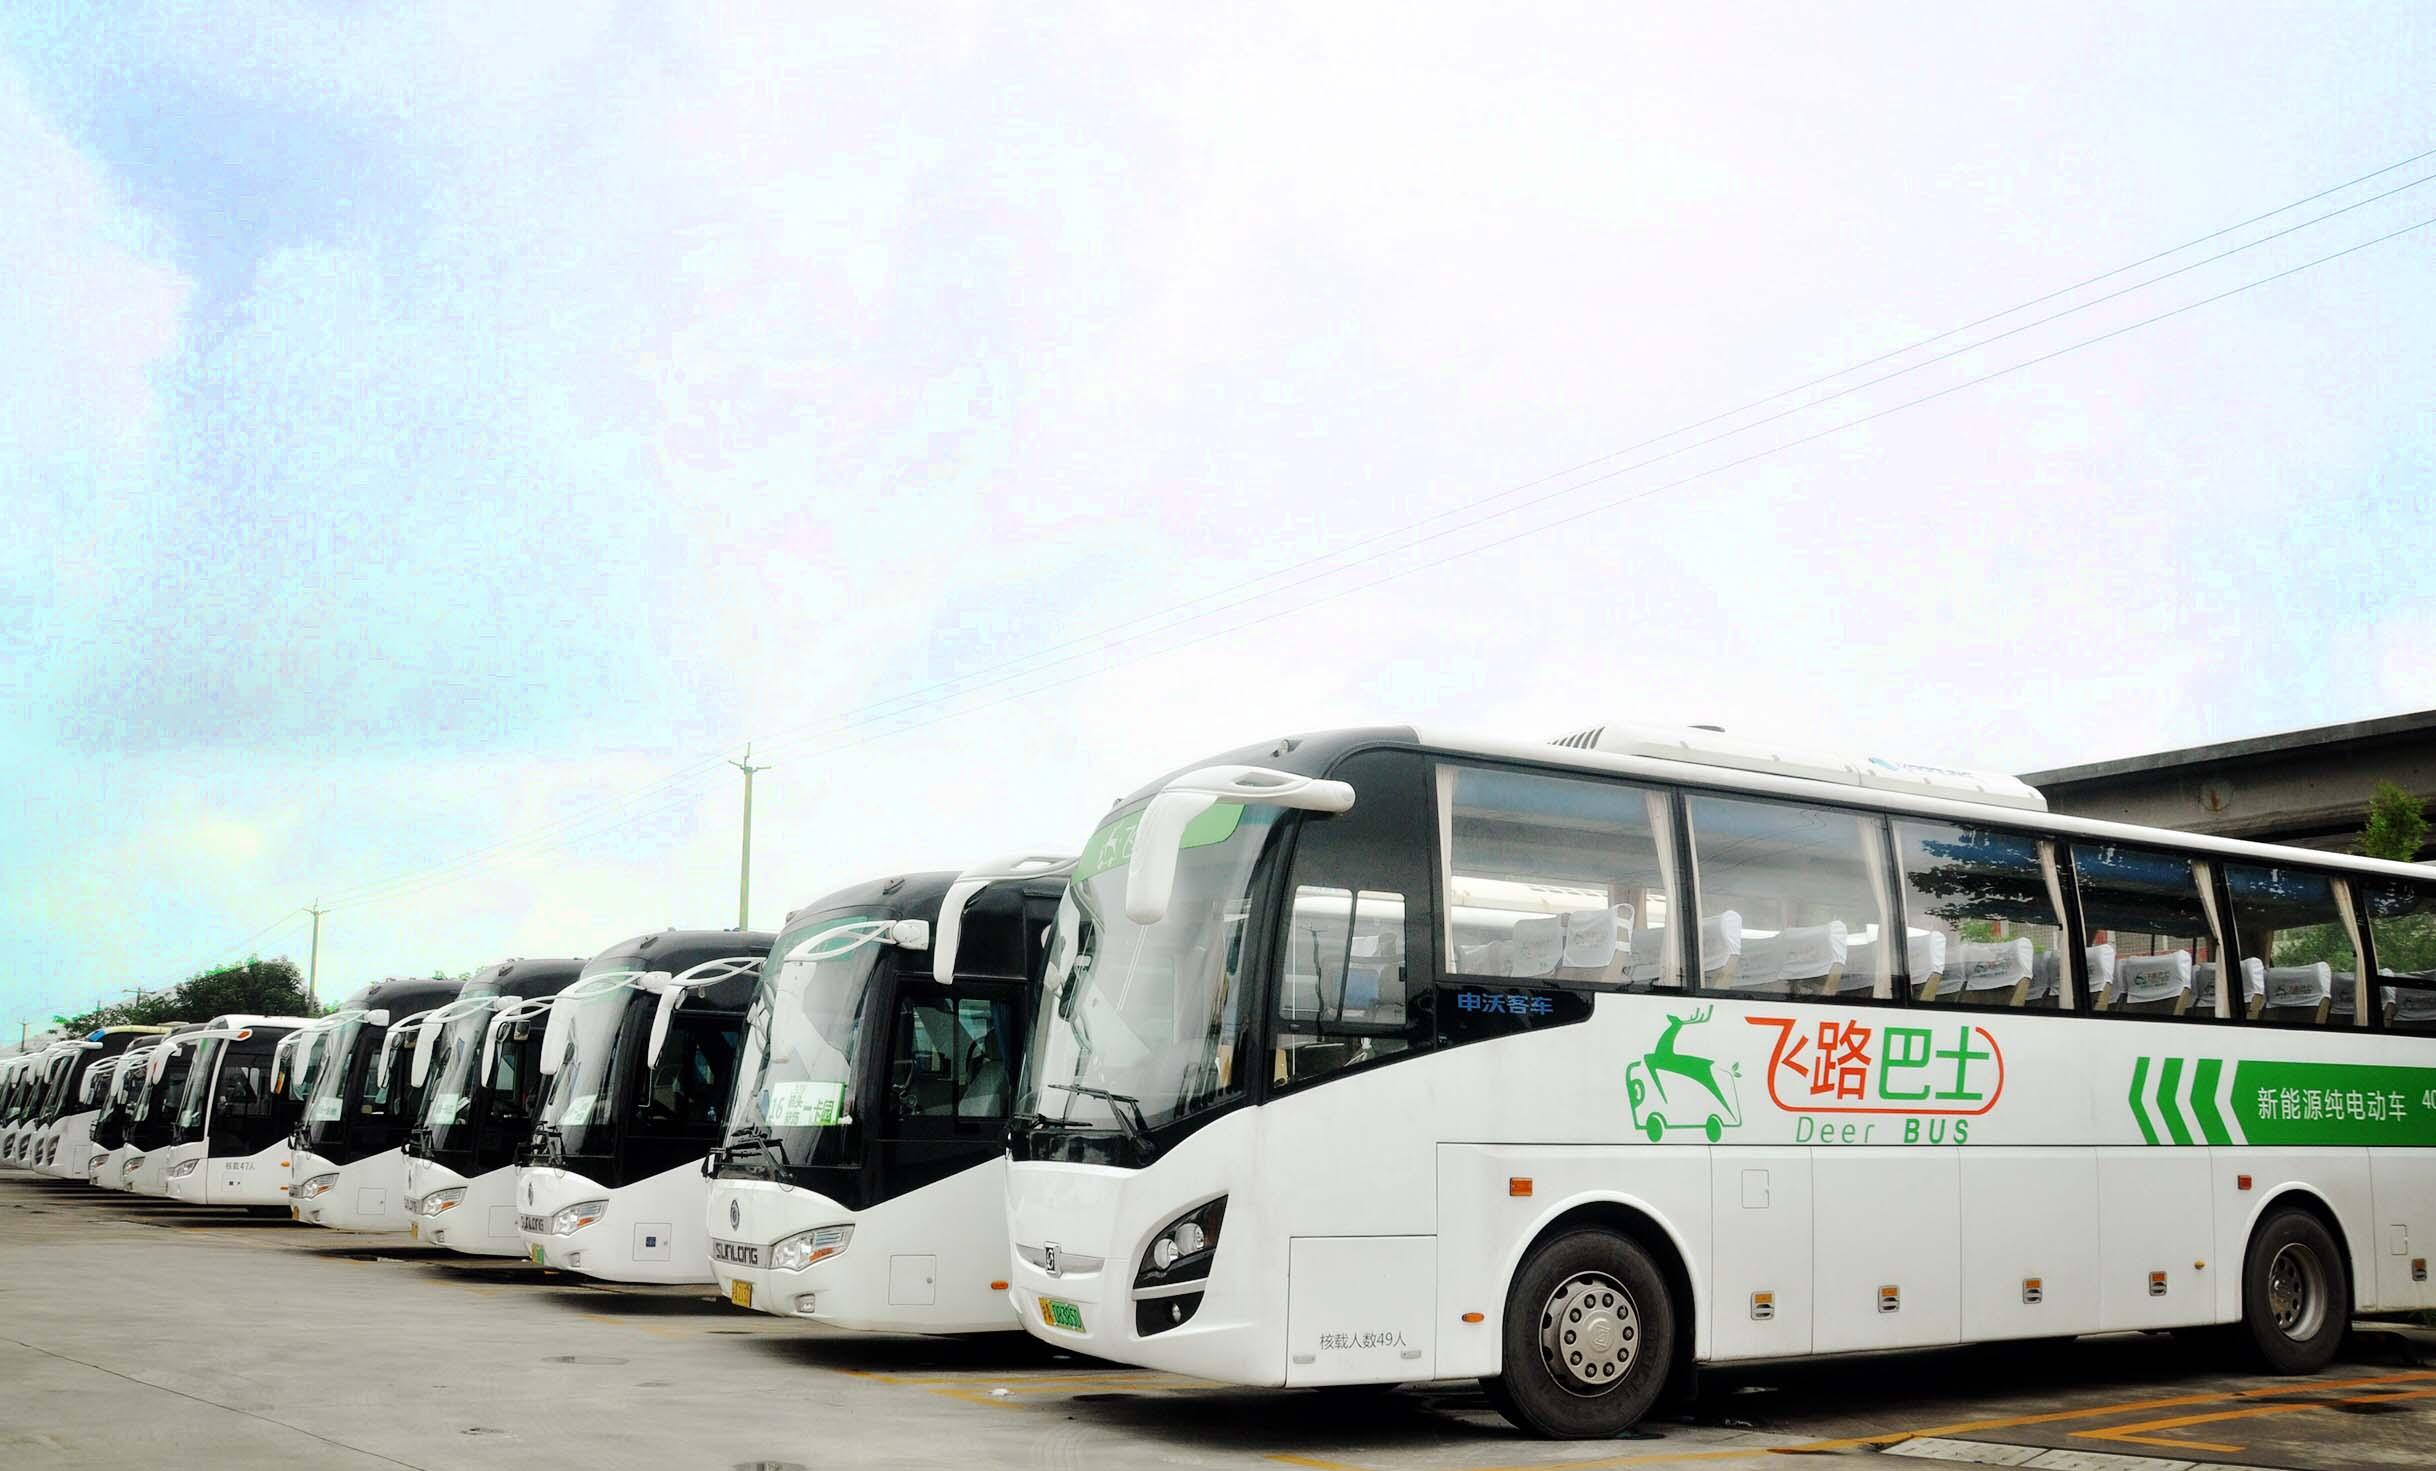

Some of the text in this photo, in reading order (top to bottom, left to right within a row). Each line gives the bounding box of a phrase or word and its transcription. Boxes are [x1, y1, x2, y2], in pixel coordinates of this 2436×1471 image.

[1457, 992, 1553, 1015] 申沃客车
[1744, 1016, 1991, 1101] 飞路巴士
[2257, 1087, 2407, 1122] 新能源纯电动车
[1796, 1116, 1969, 1144] Deer BUS
[1319, 1331, 1406, 1350] 核载人数49人
